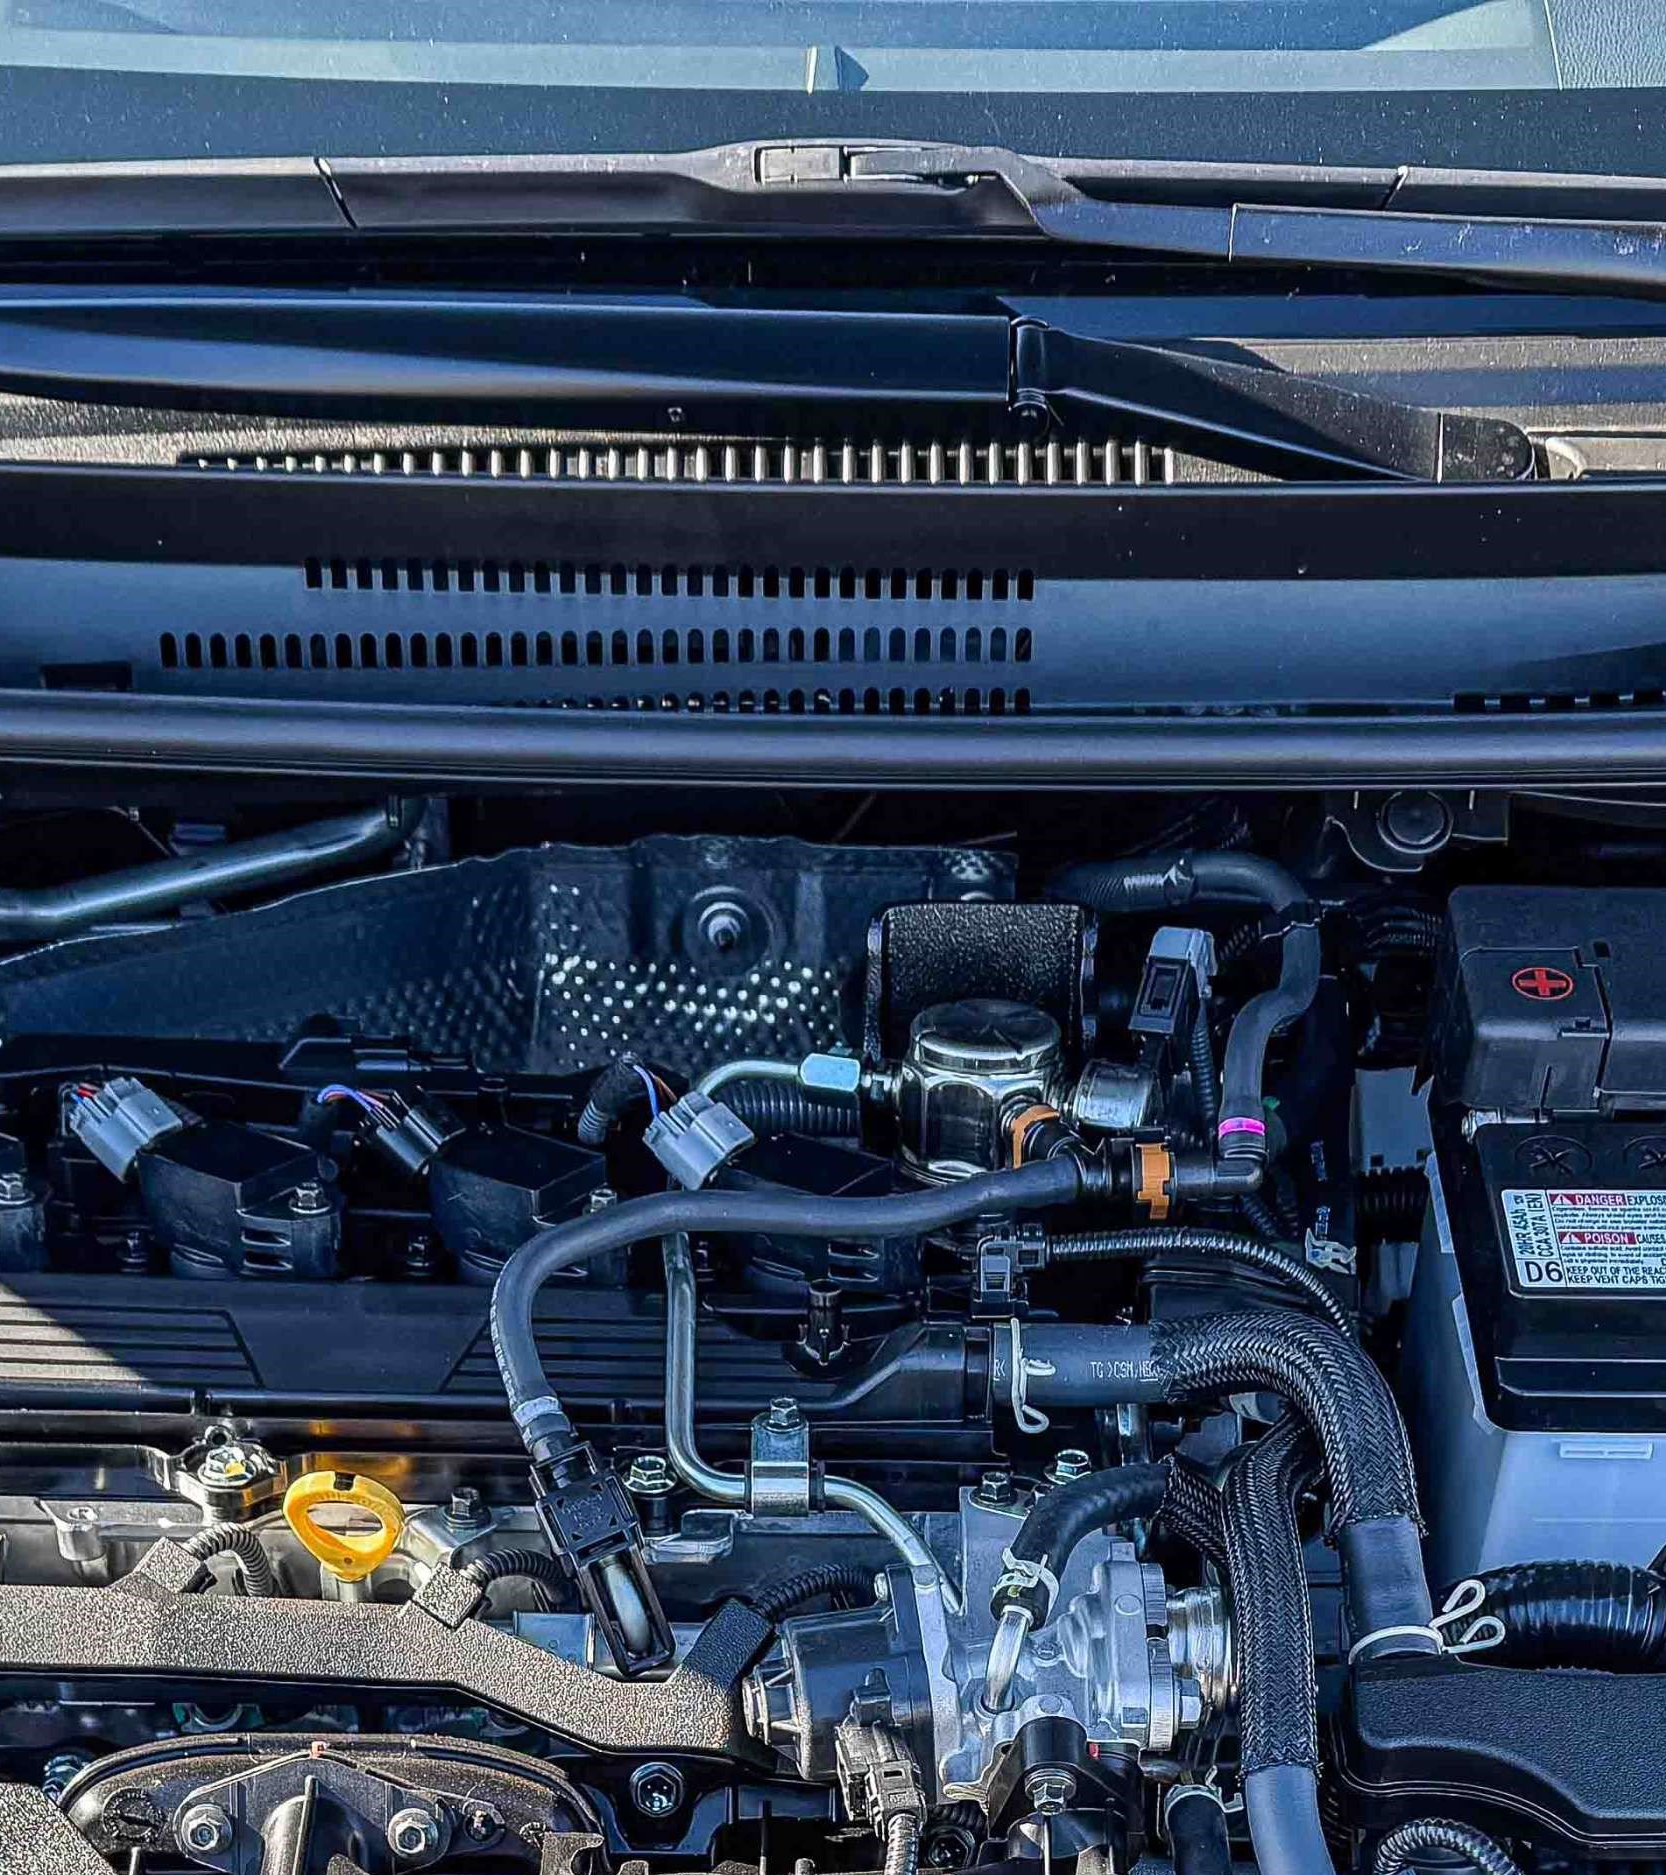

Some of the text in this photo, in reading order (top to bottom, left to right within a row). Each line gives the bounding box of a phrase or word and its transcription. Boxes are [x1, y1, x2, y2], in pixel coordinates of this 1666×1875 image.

[1576, 1194, 1624, 1206] DANGER
[1583, 1233, 1629, 1244] POISON
[1636, 1234, 1666, 1245] CAUSES
[1525, 1261, 1563, 1283] D6
[1566, 1266, 1588, 1274] KEEP
[1590, 1266, 1608, 1275] OUT
[1610, 1266, 1622, 1275] OF
[1623, 1267, 1640, 1275] THE
[1568, 1275, 1593, 1284] KEEP
[1594, 1275, 1620, 1284] VENT
[1622, 1276, 1648, 1284] CAPS
